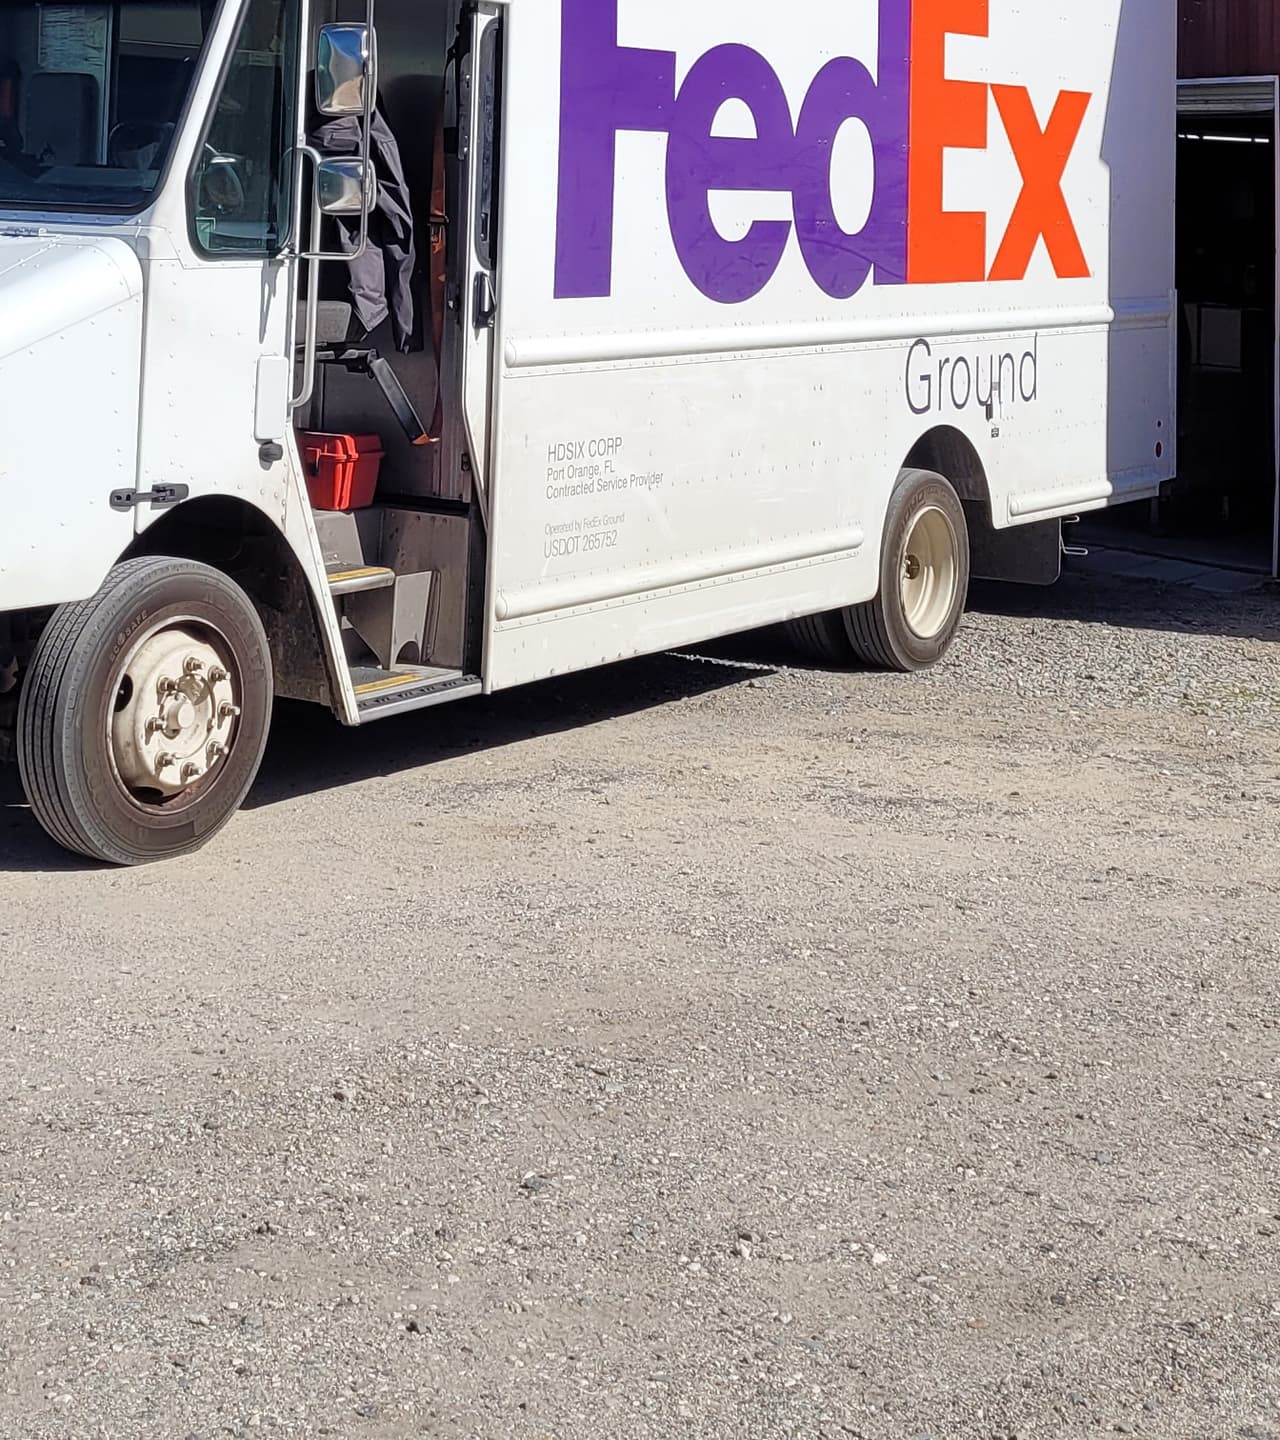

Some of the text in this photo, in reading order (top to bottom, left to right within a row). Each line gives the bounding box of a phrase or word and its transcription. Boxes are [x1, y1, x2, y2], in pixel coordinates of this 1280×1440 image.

[906, 332, 1037, 415] Ground
[547, 436, 622, 463] HDSIX CORP
[547, 460, 615, 481] Port Orange, FL
[546, 471, 664, 500] Contracted Service Provider
[544, 529, 618, 558] USDOT 265752
